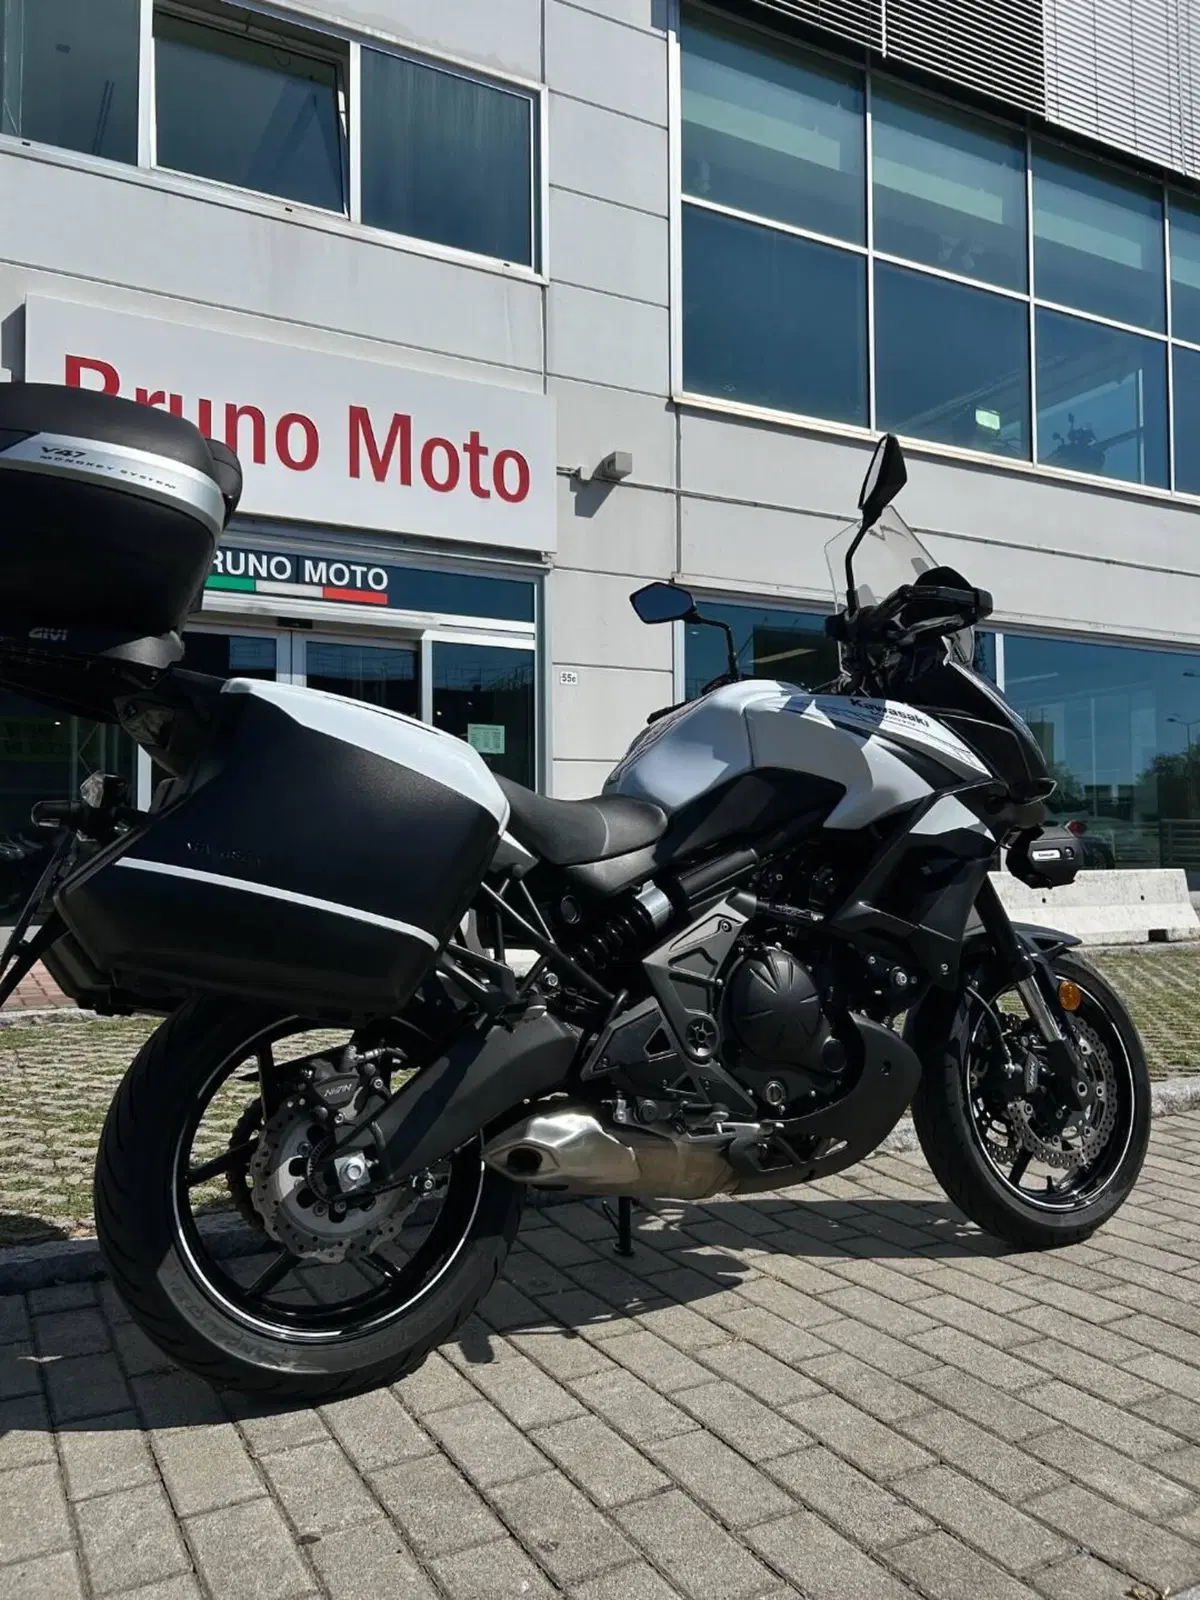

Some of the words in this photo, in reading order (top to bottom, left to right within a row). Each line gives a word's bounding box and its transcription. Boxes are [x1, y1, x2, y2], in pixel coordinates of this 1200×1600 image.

[65, 353, 319, 471] uno
[348, 404, 531, 503] Moto
[41, 446, 86, 458] V47
[120, 469, 176, 489] SYSTEM
[212, 549, 292, 580] RUNO
[304, 559, 389, 591] MOTO
[849, 698, 930, 728] Kawasaki
